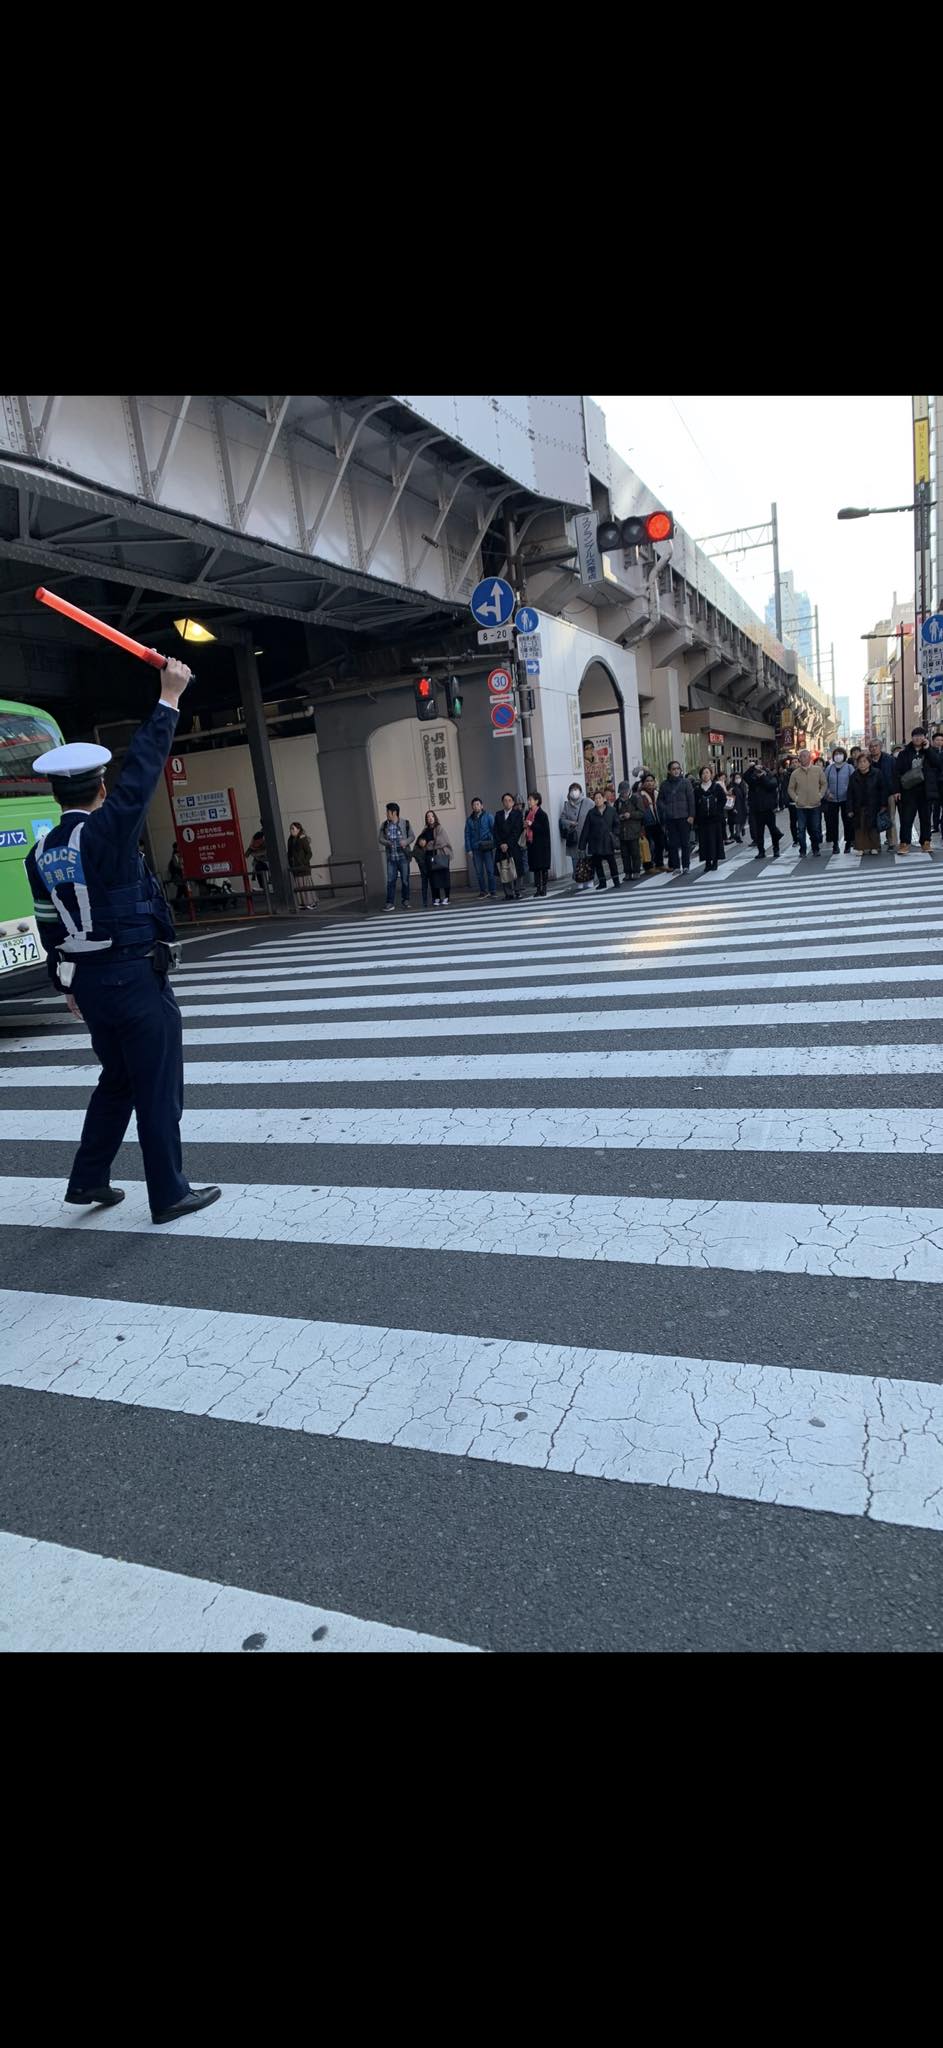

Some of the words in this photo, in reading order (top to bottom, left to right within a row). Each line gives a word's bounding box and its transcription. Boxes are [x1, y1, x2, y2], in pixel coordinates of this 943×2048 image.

[483, 629, 507, 641] 8-20
[494, 676, 507, 688] 30
[38, 848, 78, 871] POLCE
